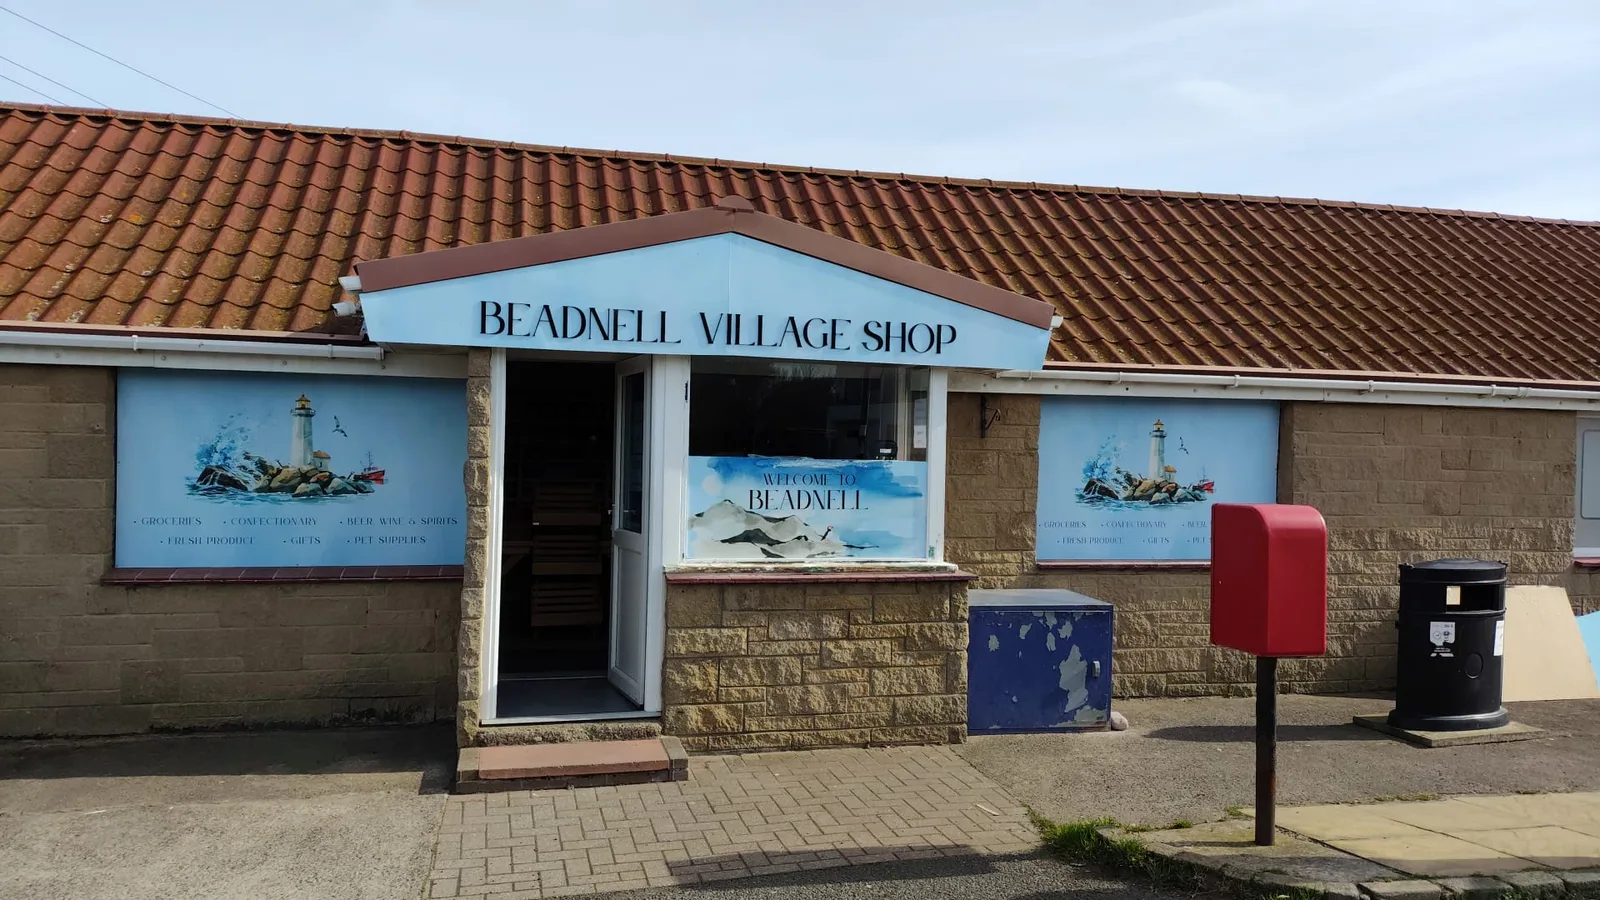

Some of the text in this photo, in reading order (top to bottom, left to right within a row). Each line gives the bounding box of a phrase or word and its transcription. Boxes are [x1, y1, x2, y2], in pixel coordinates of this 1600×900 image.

[480, 300, 957, 354] BEADNELL VILLAGE SHOP
[763, 472, 856, 486] WELCOME TO
[749, 489, 869, 510] BEADNELL
[141, 517, 202, 526] GROCERIES
[231, 517, 318, 526] CONFECTIONARY
[379, 517, 403, 526] WINE
[420, 517, 458, 526] SPIRITS
[167, 536, 255, 545] FRESH PRODUCE
[290, 536, 321, 545] GIFTS
[354, 536, 426, 545] PET SUPPLIES
